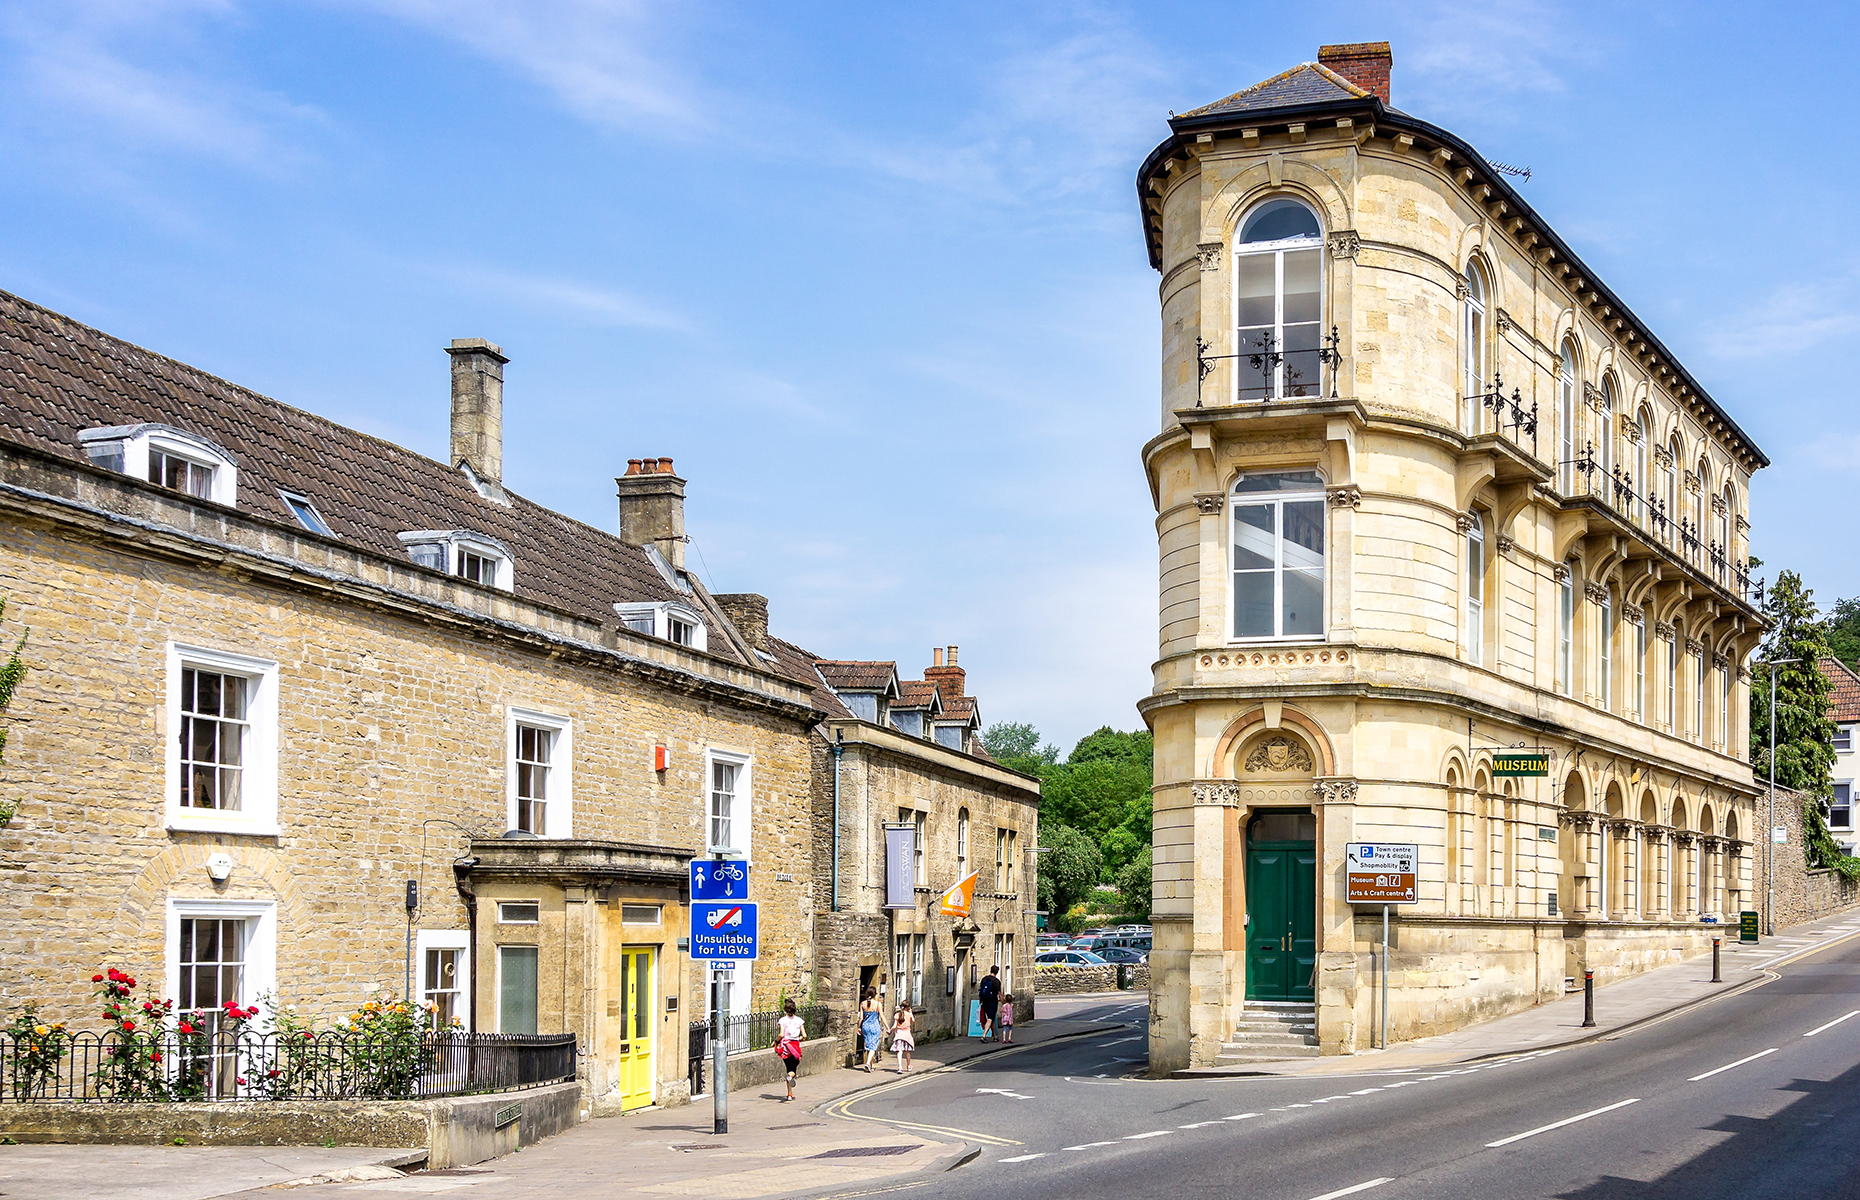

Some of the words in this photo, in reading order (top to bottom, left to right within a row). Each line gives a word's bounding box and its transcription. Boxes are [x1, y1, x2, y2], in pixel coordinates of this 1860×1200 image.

[1492, 759, 1548, 771] MUSEUM
[1369, 889, 1385, 897] Craft
[695, 934, 753, 944] Unsuitable
[698, 945, 715, 955] for
[718, 945, 750, 955] HGVs
